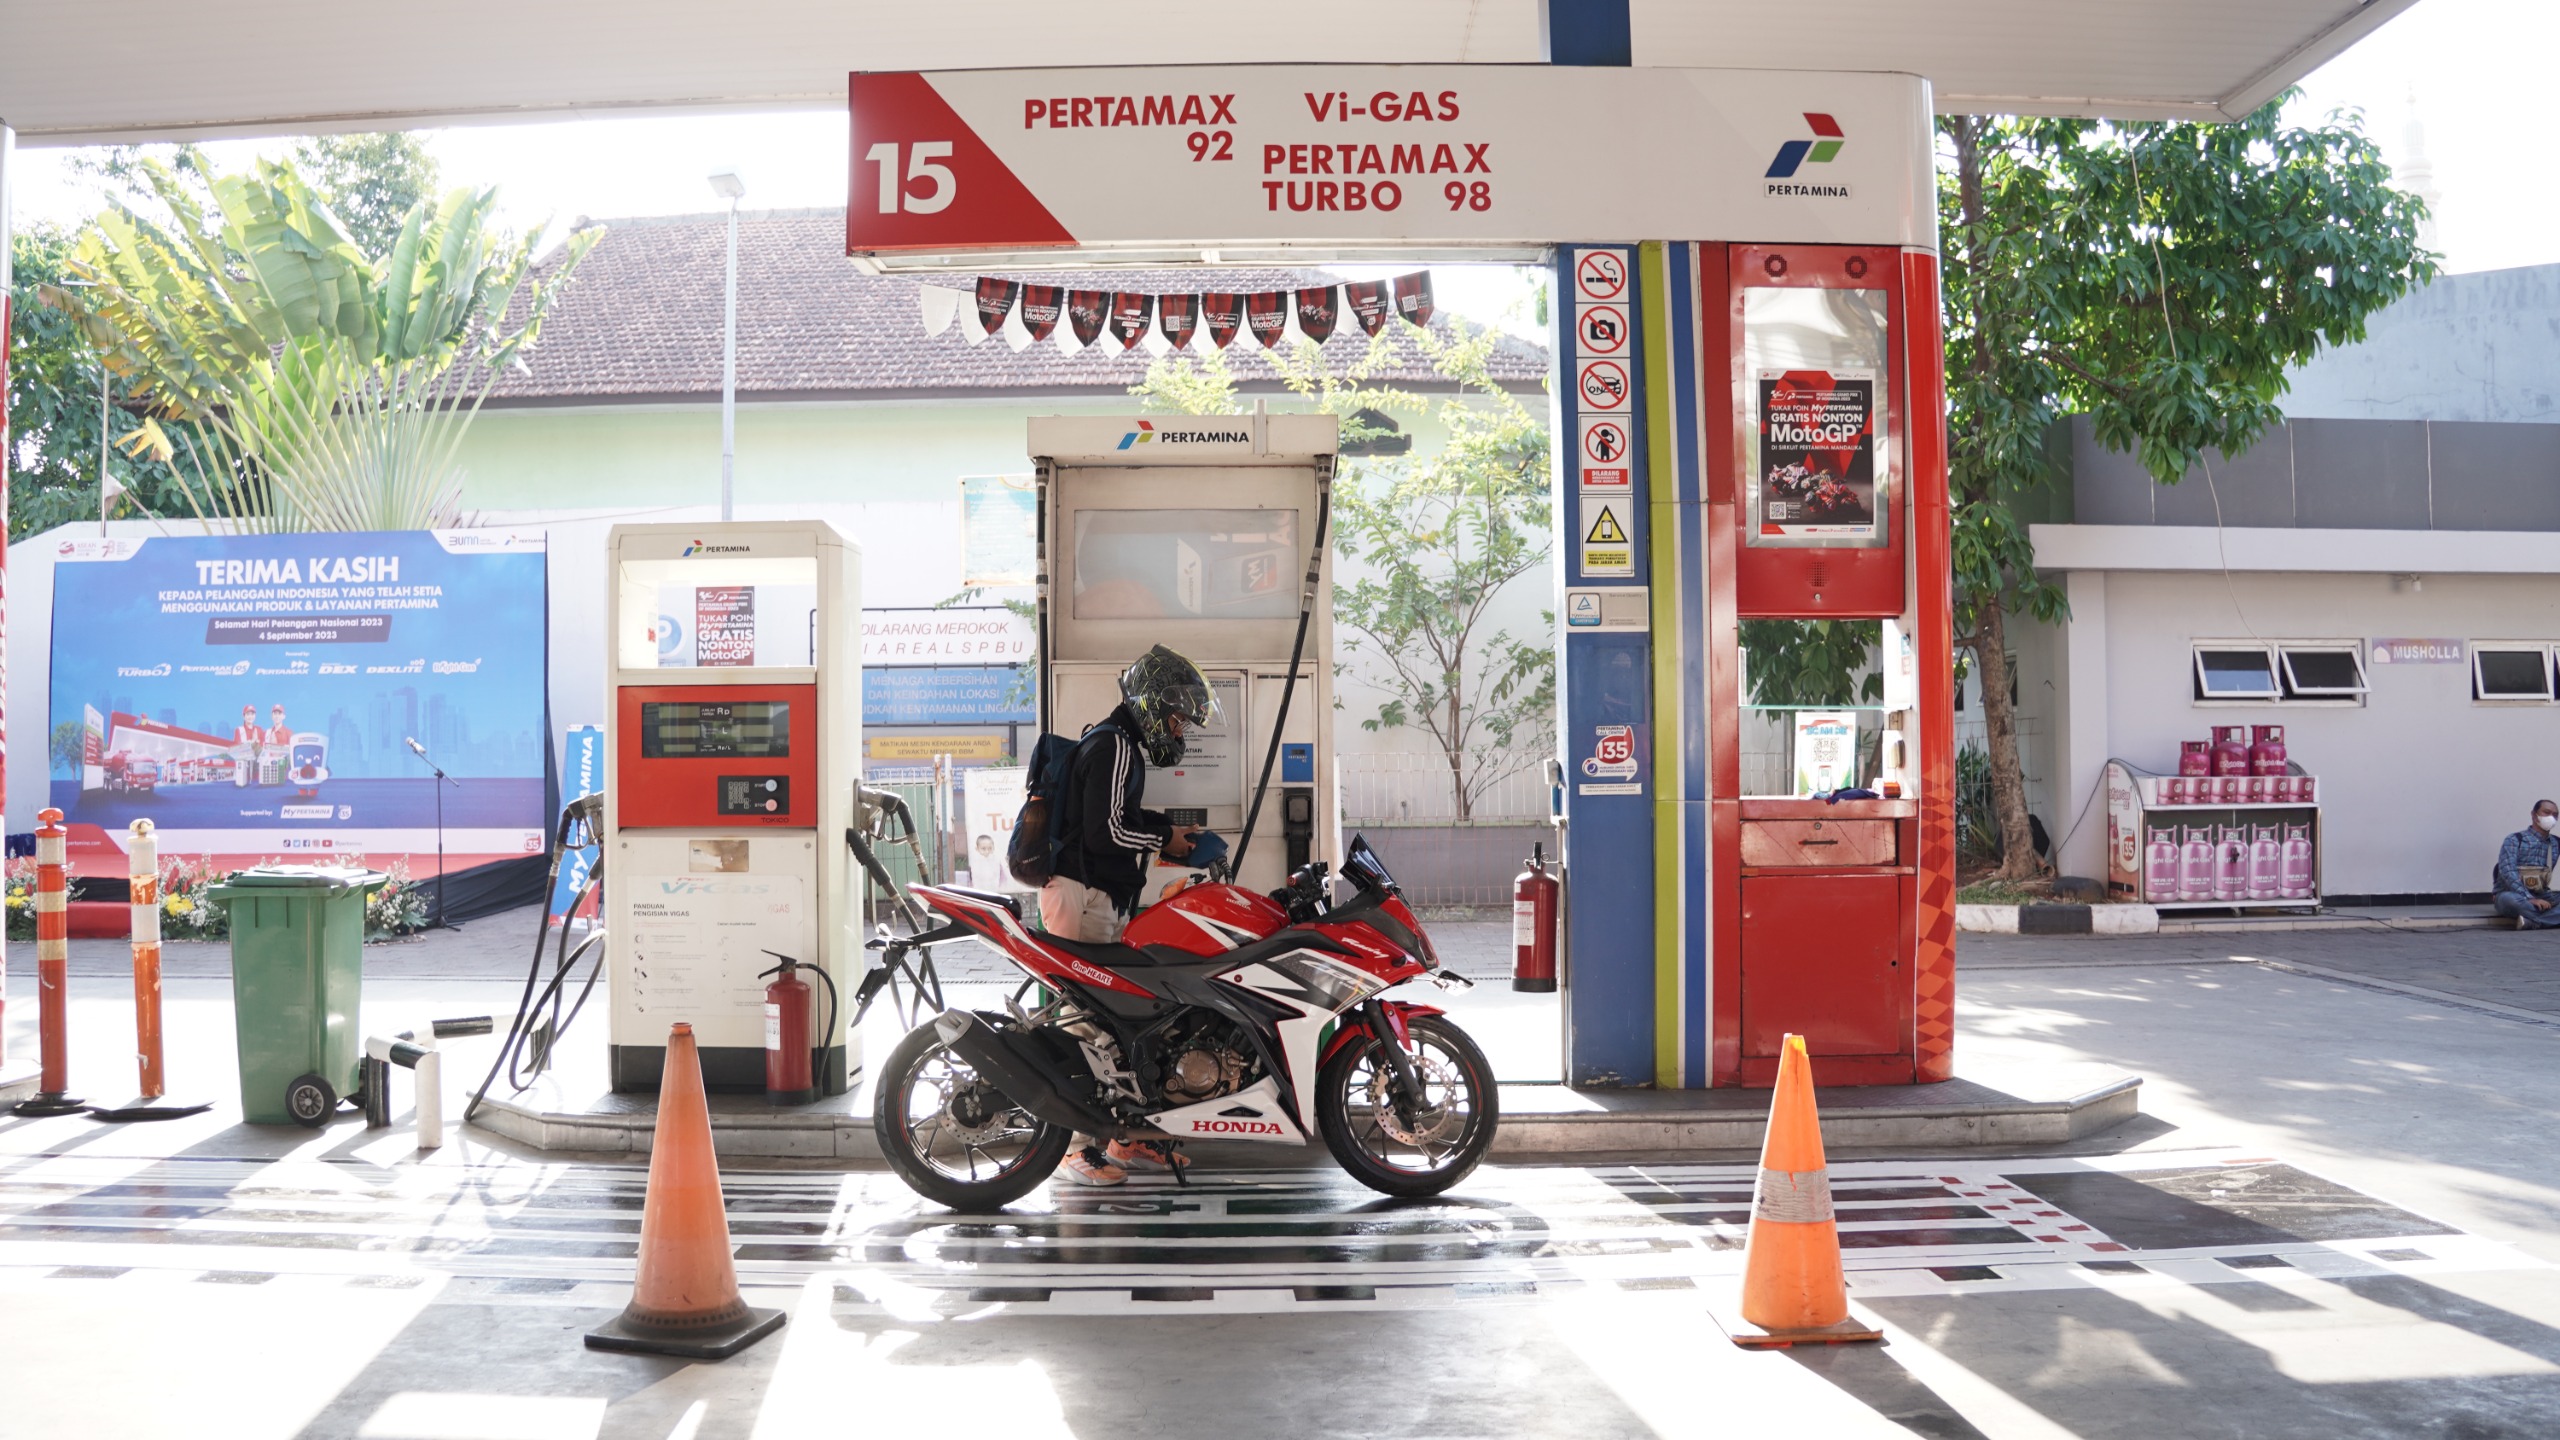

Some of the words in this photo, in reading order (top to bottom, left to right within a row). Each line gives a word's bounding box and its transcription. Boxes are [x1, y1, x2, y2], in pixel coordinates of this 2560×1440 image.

[1024, 93, 1238, 130] PERTAMAX
[1303, 90, 1461, 123] Vi-GAS
[1186, 130, 1234, 163] 92
[1263, 143, 1493, 175] PERTAMAX
[864, 140, 957, 215] 15
[1261, 180, 1403, 213] TURBO
[1443, 180, 1493, 213] 98
[1767, 184, 1849, 198] PERTAMINA
[1024, 311, 1056, 322] MotoGP
[1251, 319, 1284, 330] MotoGP
[1771, 413, 1810, 423] GRATIS
[1812, 413, 1862, 423] NONTON
[1161, 432, 1250, 443] PERTAMINA
[706, 545, 751, 553] PERTAMINA
[195, 558, 302, 586] TERIMA
[309, 556, 400, 584] KASIH
[158, 589, 203, 601] KEPADA
[205, 588, 275, 601] PELANGGAN
[277, 587, 339, 600] INDONESIA
[341, 586, 376, 598] YANG
[377, 586, 411, 598] TELAH
[413, 585, 443, 597] SETIA
[161, 601, 253, 613] MENGGUNAKAN
[255, 601, 303, 612] PRODUK
[304, 600, 313, 610] &
[315, 599, 372, 610] LAYANAN
[374, 598, 439, 610] PERTAMINA
[214, 619, 250, 629] Selamat
[251, 619, 270, 628] Hari
[271, 618, 318, 631] Pelanggan
[320, 617, 359, 627] Nasional
[360, 617, 383, 627] 2023
[699, 614, 728, 623] TUKAR
[730, 614, 754, 622] POIN
[698, 629, 754, 641] GRATIS
[861, 624, 932, 636] DILARANG
[935, 622, 1009, 635] MEROKOK
[259, 632, 265, 640] 4
[266, 631, 313, 642] September
[315, 630, 338, 640] 2023
[698, 641, 754, 651] NONTON
[878, 642, 954, 655] AREAL
[961, 640, 1024, 655] SPBU
[2393, 645, 2460, 659] MUSHOLLA
[698, 649, 751, 660] MotoGP
[180, 665, 233, 673] PERTAMAX
[256, 667, 310, 676] PERTAMAX
[318, 665, 358, 674] DEX
[366, 666, 424, 674] DEXLITE
[870, 676, 925, 686] MENJAGA
[927, 674, 998, 686] KEBERSIHAN
[868, 690, 891, 700] DAN
[893, 689, 957, 700] KEINDAHAN
[960, 688, 1000, 700] LOKASI
[900, 703, 976, 714] KENYAMANAN
[1191, 1120, 1284, 1135] HONDA
